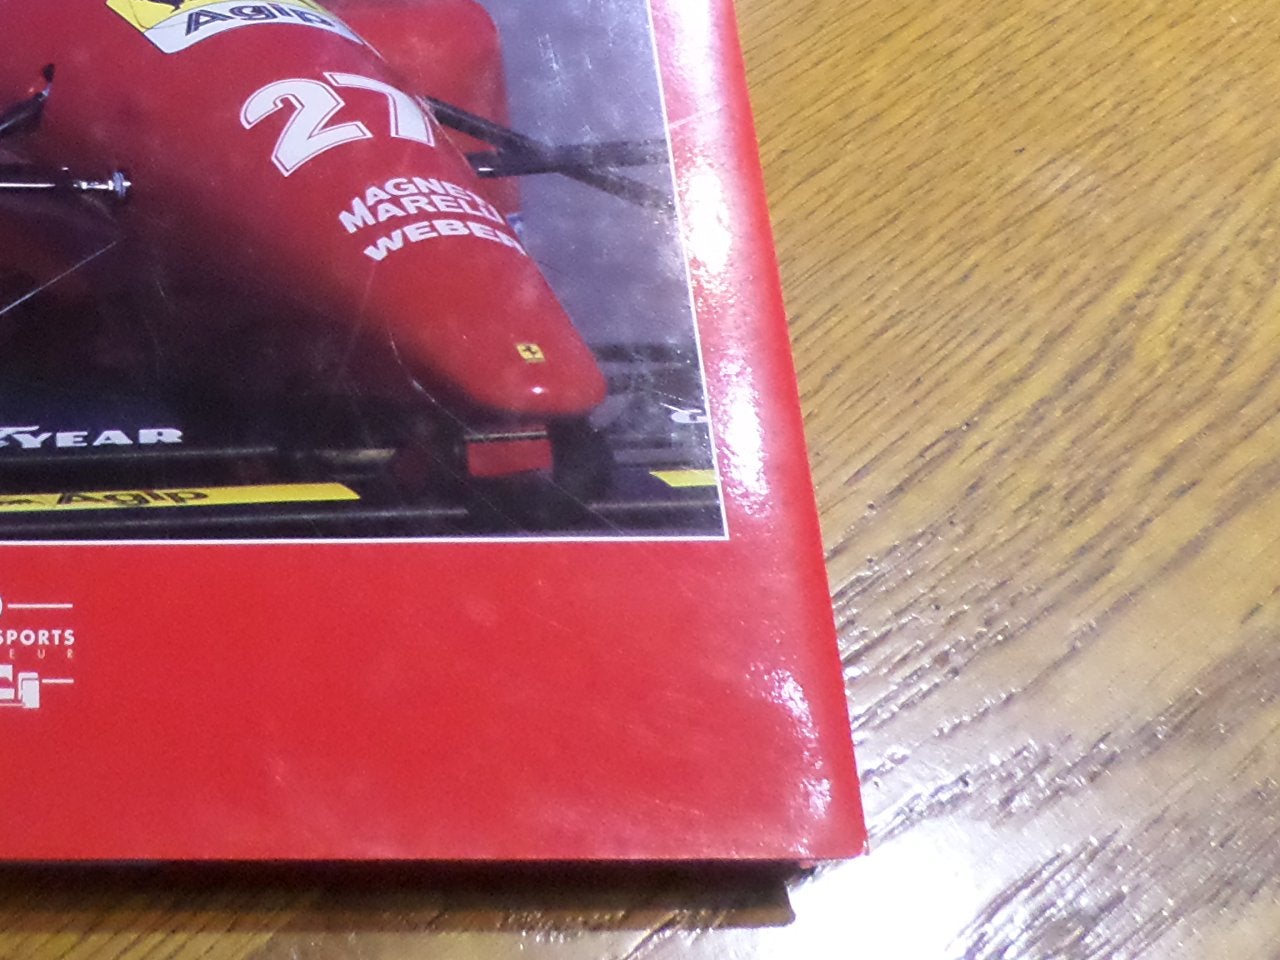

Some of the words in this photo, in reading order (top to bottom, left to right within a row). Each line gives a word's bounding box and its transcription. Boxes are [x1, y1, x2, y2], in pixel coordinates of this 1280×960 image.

[185, 2, 336, 36] Agip
[240, 71, 436, 178] 27
[56, 490, 209, 507] Agip
